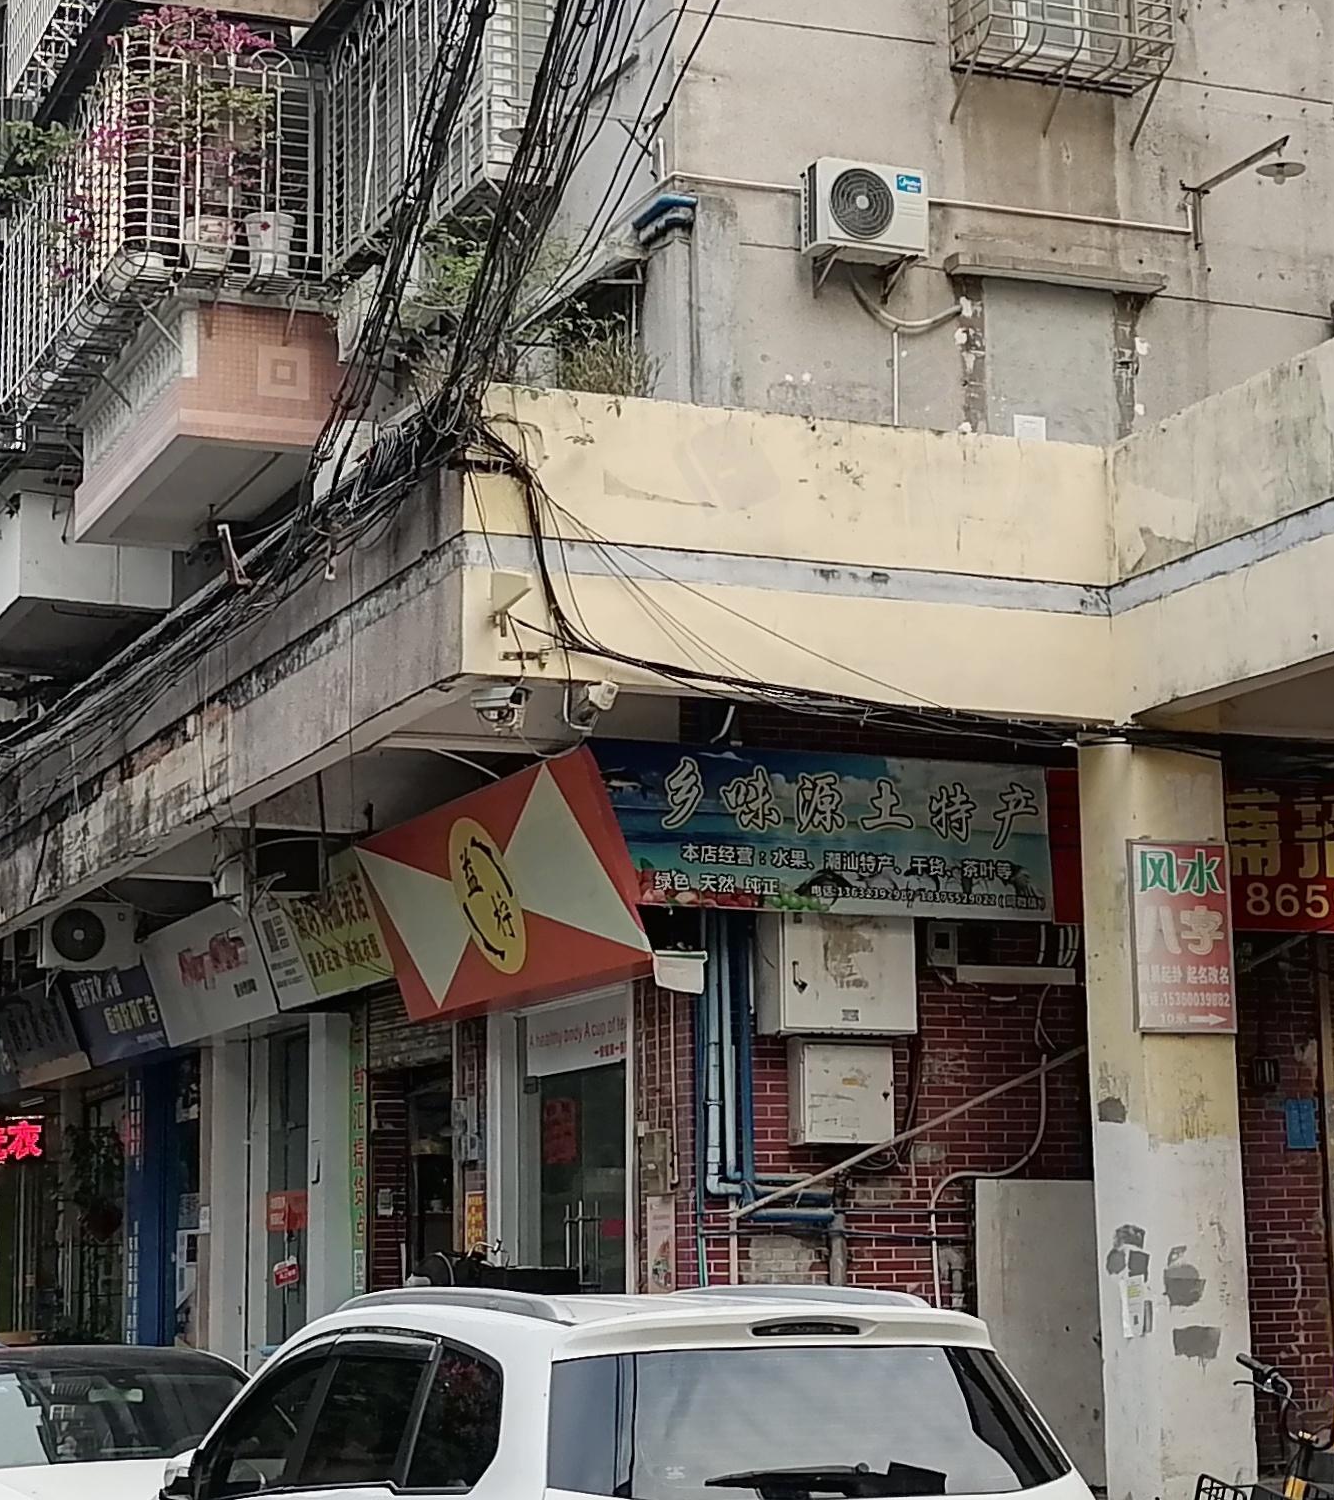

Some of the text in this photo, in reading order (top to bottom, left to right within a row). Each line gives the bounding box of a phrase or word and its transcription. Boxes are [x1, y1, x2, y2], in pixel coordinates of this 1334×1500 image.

[661, 755, 1039, 850] 乡味源土特产
[655, 871, 780, 896] 绿色 天然 纯正
[1139, 849, 1226, 896] 风水
[1138, 905, 1225, 955] 八字
